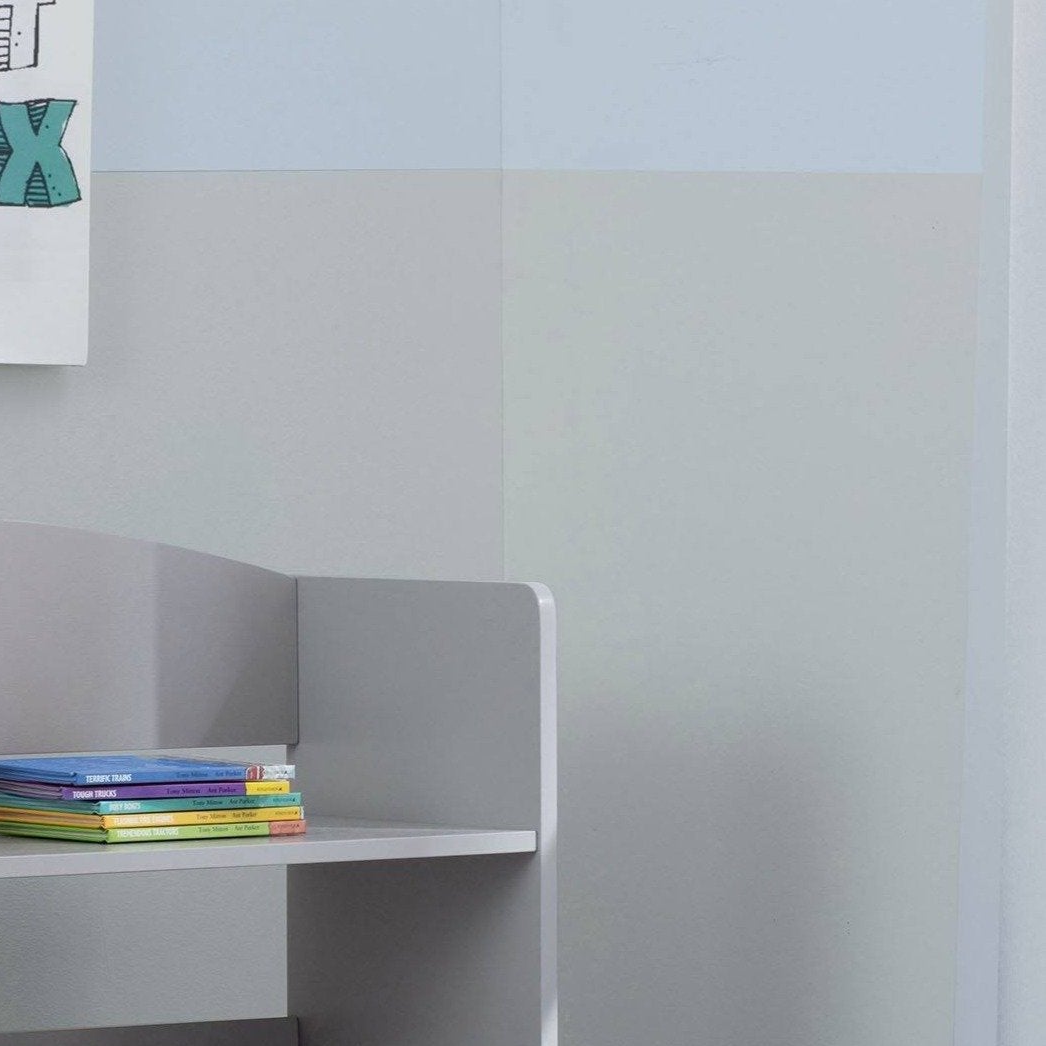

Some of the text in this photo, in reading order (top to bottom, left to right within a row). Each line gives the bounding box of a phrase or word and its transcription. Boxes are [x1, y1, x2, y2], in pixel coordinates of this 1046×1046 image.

[85, 773, 132, 783] TERRIFIC TRAINS
[73, 789, 117, 799] TOUGH TRUCKS
